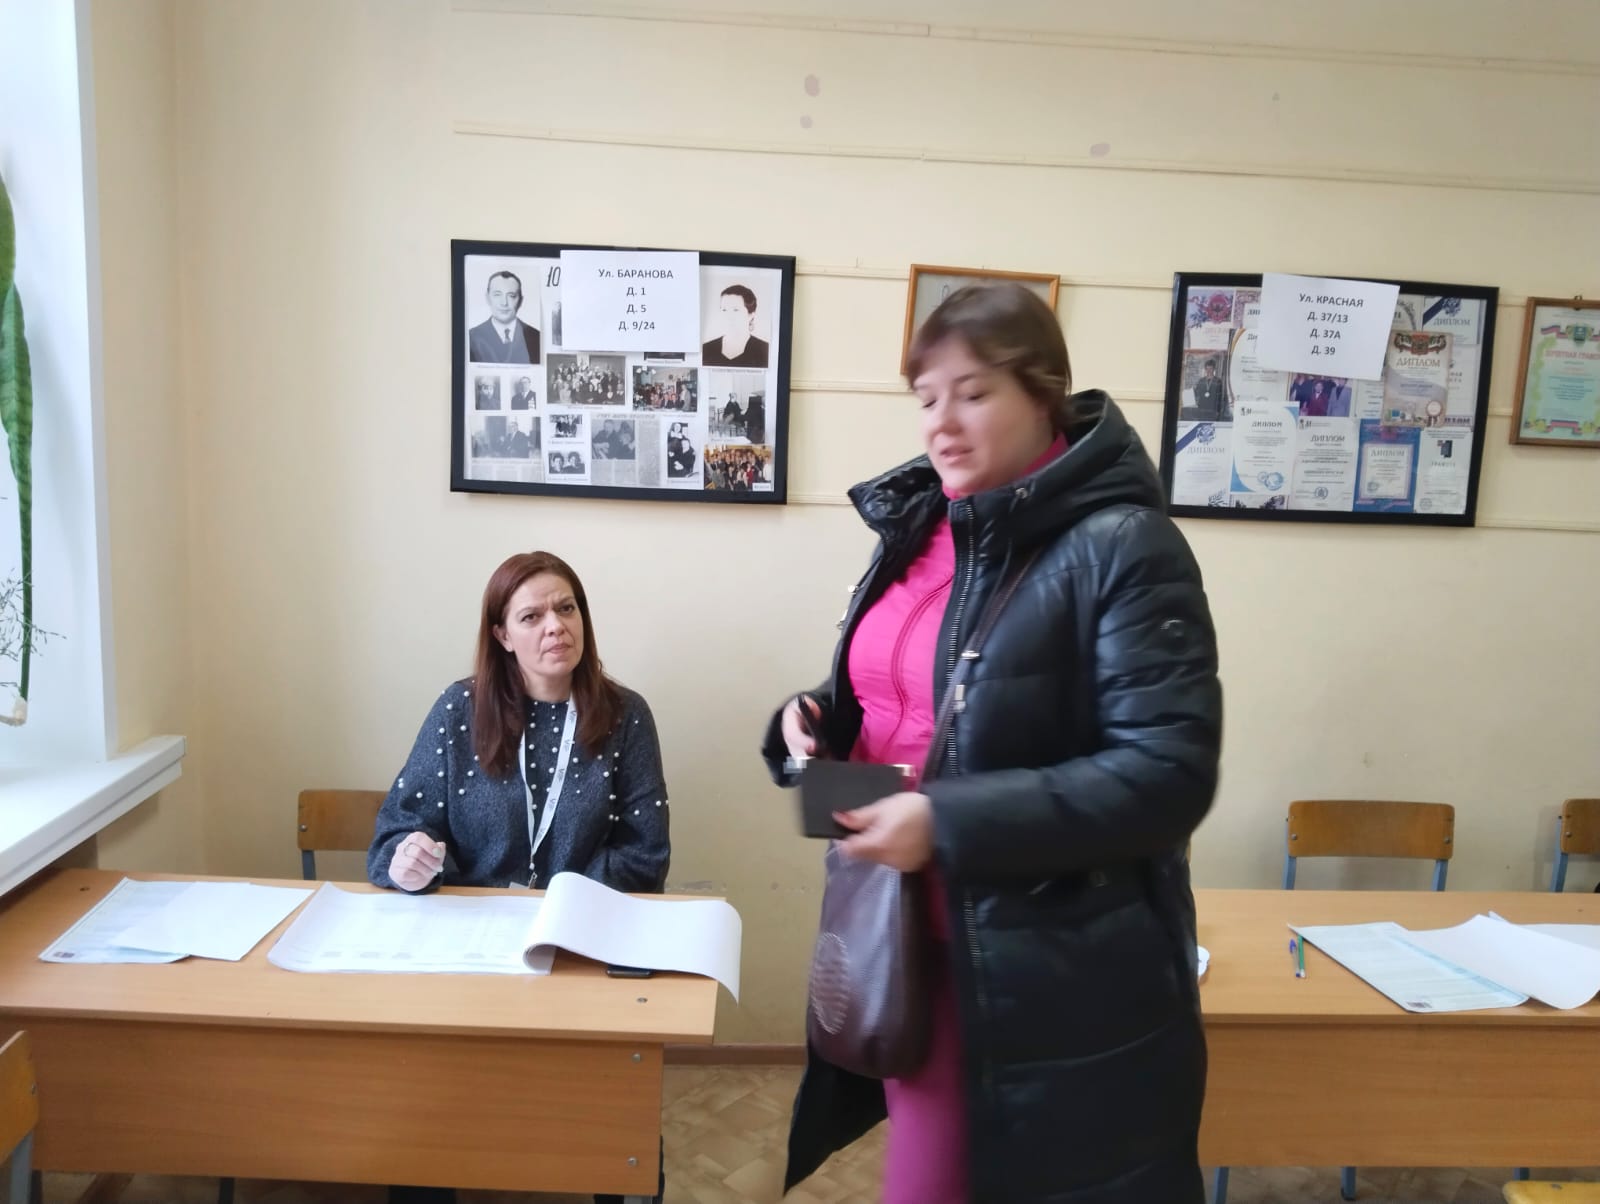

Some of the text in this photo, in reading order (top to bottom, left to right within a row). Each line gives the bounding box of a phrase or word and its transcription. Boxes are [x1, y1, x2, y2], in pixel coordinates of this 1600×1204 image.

[598, 268, 674, 279] Ул. БАРАНОВА
[626, 286, 646, 297] Д. 1
[1299, 293, 1364, 308] Ул. КРАСНАЯ
[626, 303, 647, 314] Д. 5
[1307, 311, 1349, 323] Д. 37/13
[618, 320, 655, 332] Д. 9/24
[1309, 328, 1341, 340] Д. 37А
[1311, 345, 1336, 356] Д. 39
[1396, 356, 1441, 367] ДИПЛОМ
